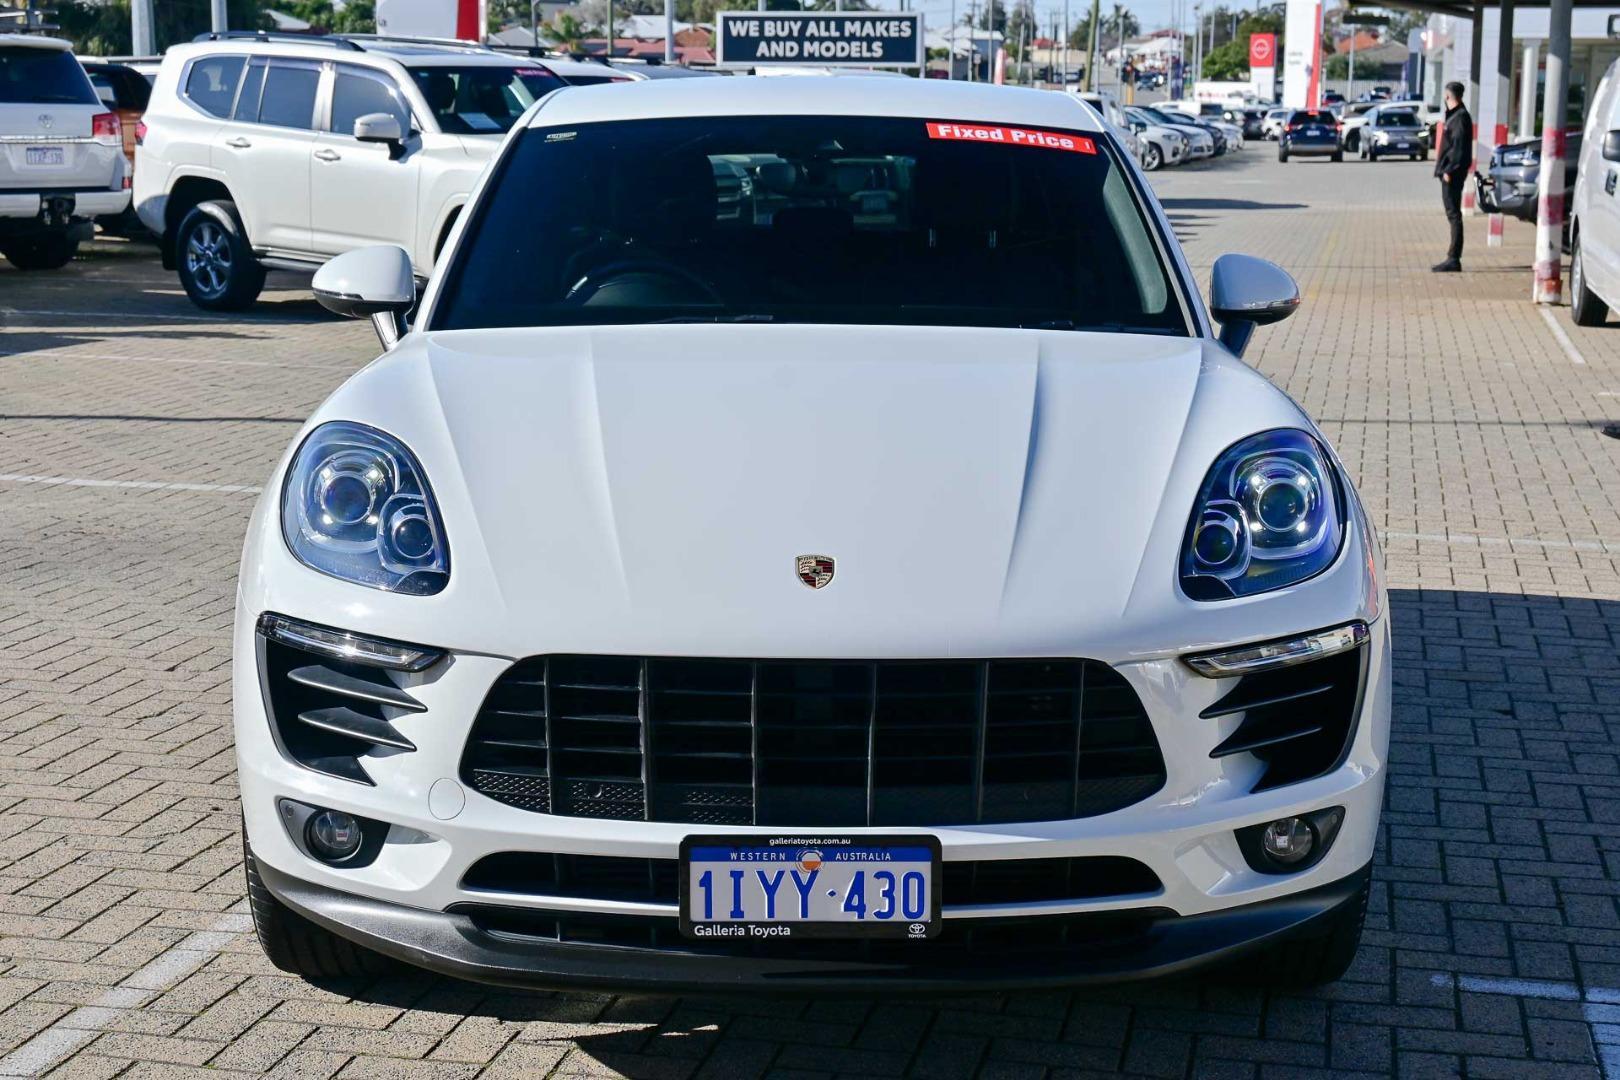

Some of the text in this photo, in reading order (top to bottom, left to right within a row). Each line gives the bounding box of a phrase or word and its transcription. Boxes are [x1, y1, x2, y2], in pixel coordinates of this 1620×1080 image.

[728, 20, 912, 38] WE BUY ALL MAKES
[755, 41, 884, 58] AND MODELS
[937, 124, 1074, 149] Fixed Price
[769, 837, 851, 846] galleriatoyota.com.au
[730, 852, 892, 861] WESTERN AUSTRALIA
[694, 924, 791, 938] Galleria Toyota
